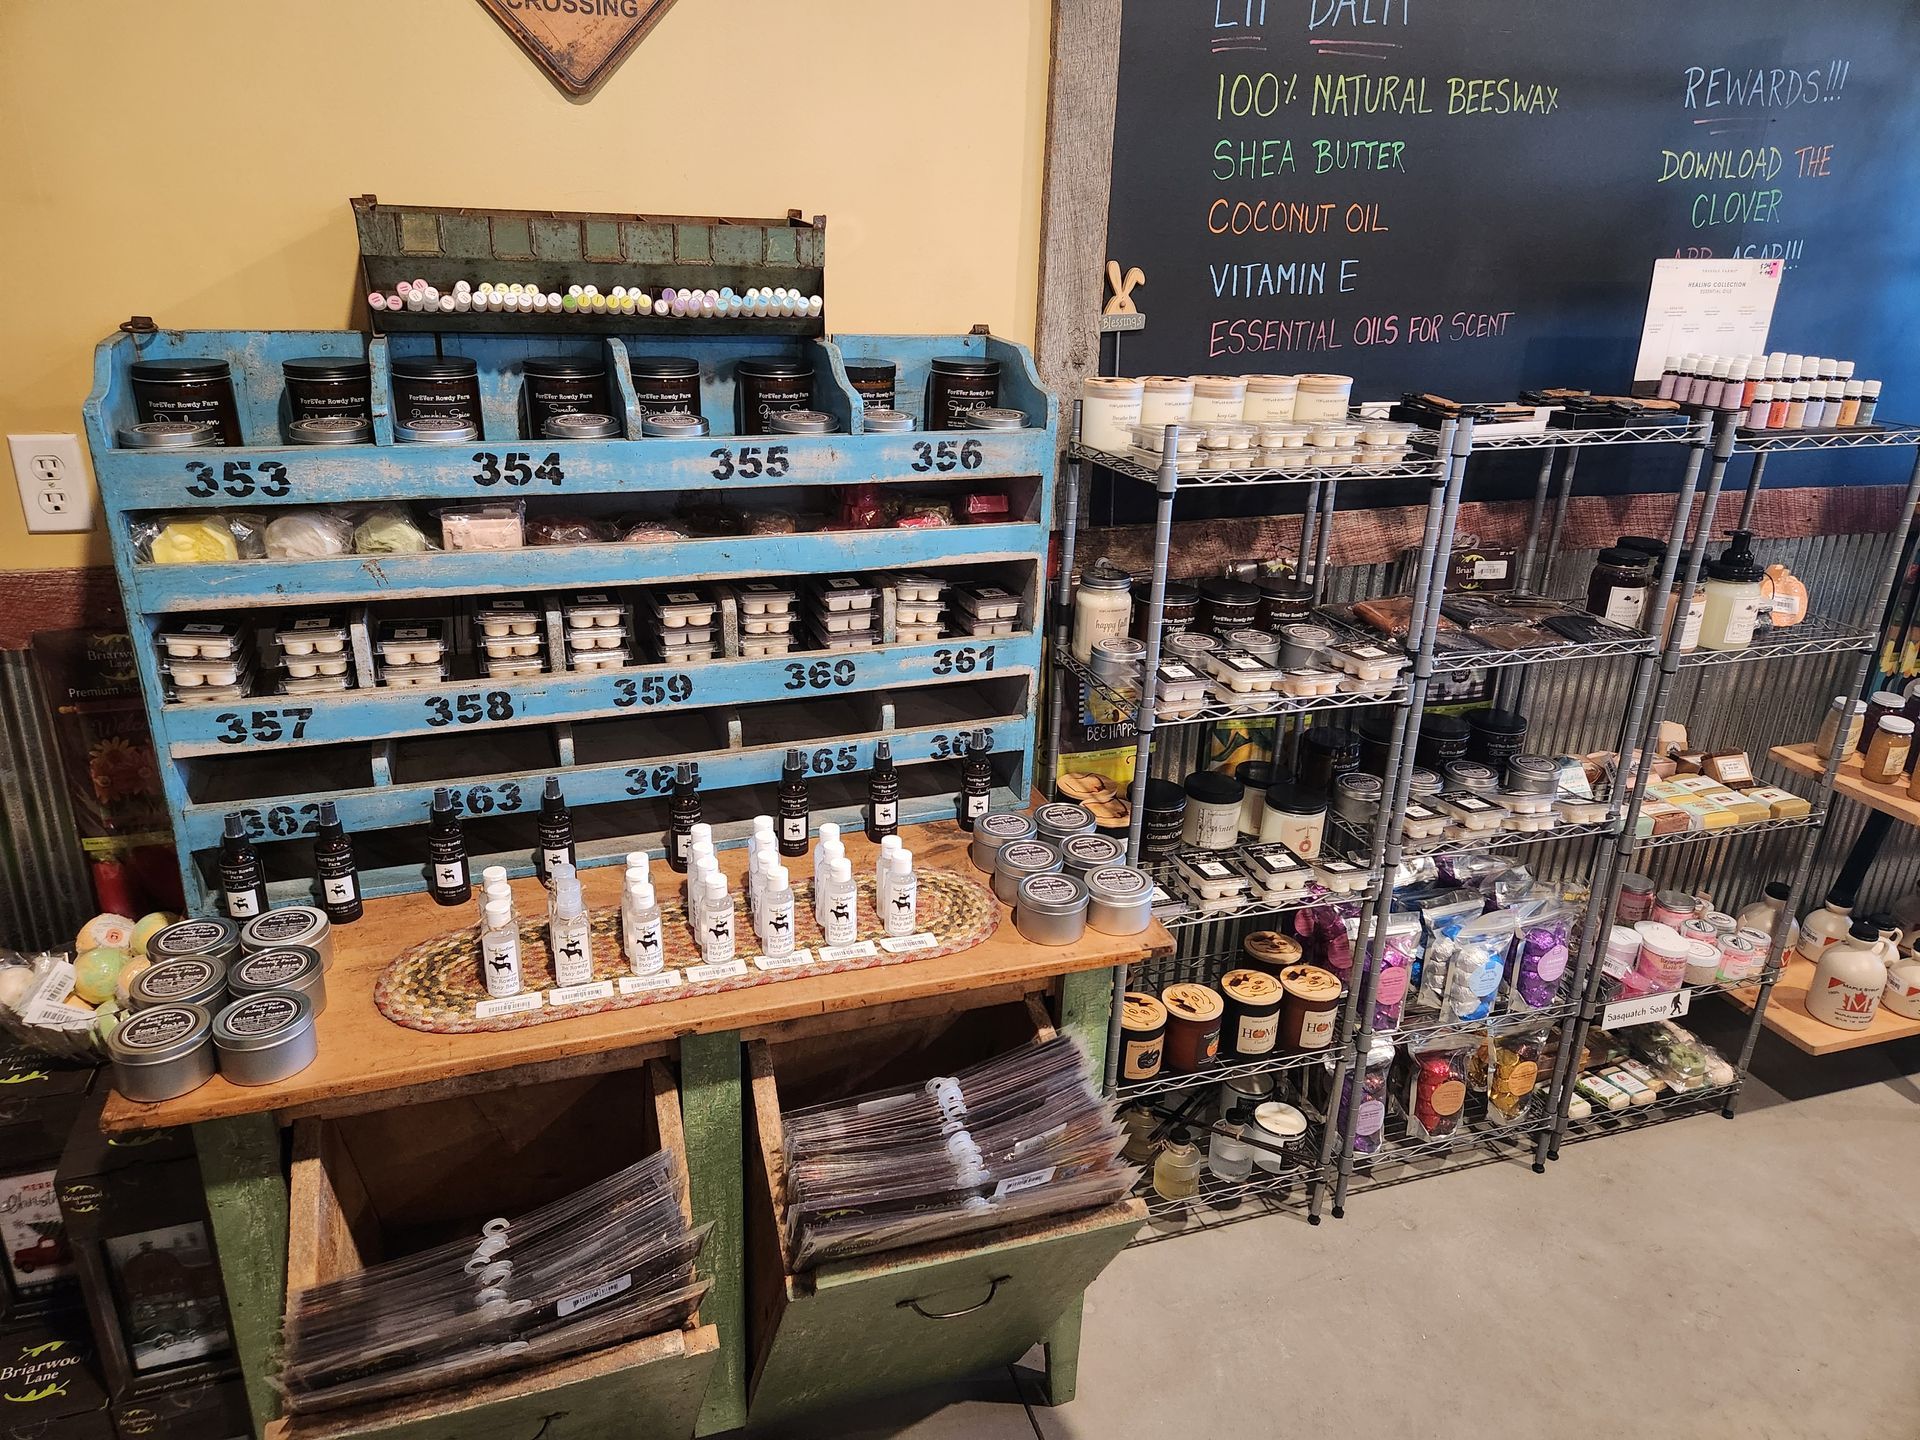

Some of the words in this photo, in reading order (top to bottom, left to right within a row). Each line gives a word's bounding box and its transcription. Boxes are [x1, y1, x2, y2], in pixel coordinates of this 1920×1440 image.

[1217, 72, 1298, 121] 100%
[1312, 73, 1433, 117] NATURAL
[1447, 77, 1559, 115] BEESWAX
[1683, 59, 1850, 110] REWARDS!!!
[1212, 139, 1297, 181] SHEA
[1312, 139, 1406, 175] BUTTER
[1657, 146, 1782, 183] DOWNLOAD
[1795, 144, 1834, 178] THE
[1208, 198, 1336, 235] COCONUT
[1346, 203, 1389, 233] OIL
[1691, 188, 1783, 229] CLOVER
[1209, 262, 1326, 299] VITAMIN
[1339, 259, 1360, 293] E
[1103, 316, 1141, 329] Blessings
[1209, 318, 1343, 358] ESSENTIAL
[1354, 315, 1399, 346] OILS
[1408, 314, 1444, 344] FOR
[1449, 311, 1516, 342] SCENT
[177, 401, 201, 409] Rowdy
[549, 404, 578, 413] Sweater
[948, 400, 973, 417] Spiced
[472, 452, 565, 486] 354
[710, 446, 790, 480] 355
[911, 439, 983, 472] 356
[184, 461, 292, 498] 353
[1456, 566, 1475, 574] Briar
[1096, 619, 1116, 631] happy
[1167, 625, 1186, 633] Maple
[784, 659, 856, 690] 360
[932, 645, 996, 675] 361
[69, 686, 120, 698] Premium
[613, 674, 693, 706] 359
[424, 691, 515, 727] 358
[215, 707, 313, 744] 357
[1087, 726, 1107, 741] BEE
[1109, 722, 1138, 739] HAPPY
[240, 803, 320, 838] 362
[1211, 824, 1235, 833] Winter
[1147, 832, 1171, 840] Caramel
[1842, 983, 1862, 992] MAPLE
[1607, 1008, 1647, 1023] Sasquatch
[1650, 1004, 1667, 1015] Soap
[135, 1026, 159, 1035] Keep
[22, 1182, 52, 1191] MERR
[1, 1355, 82, 1381] Briarwoo
[24, 1371, 60, 1386] Lane
